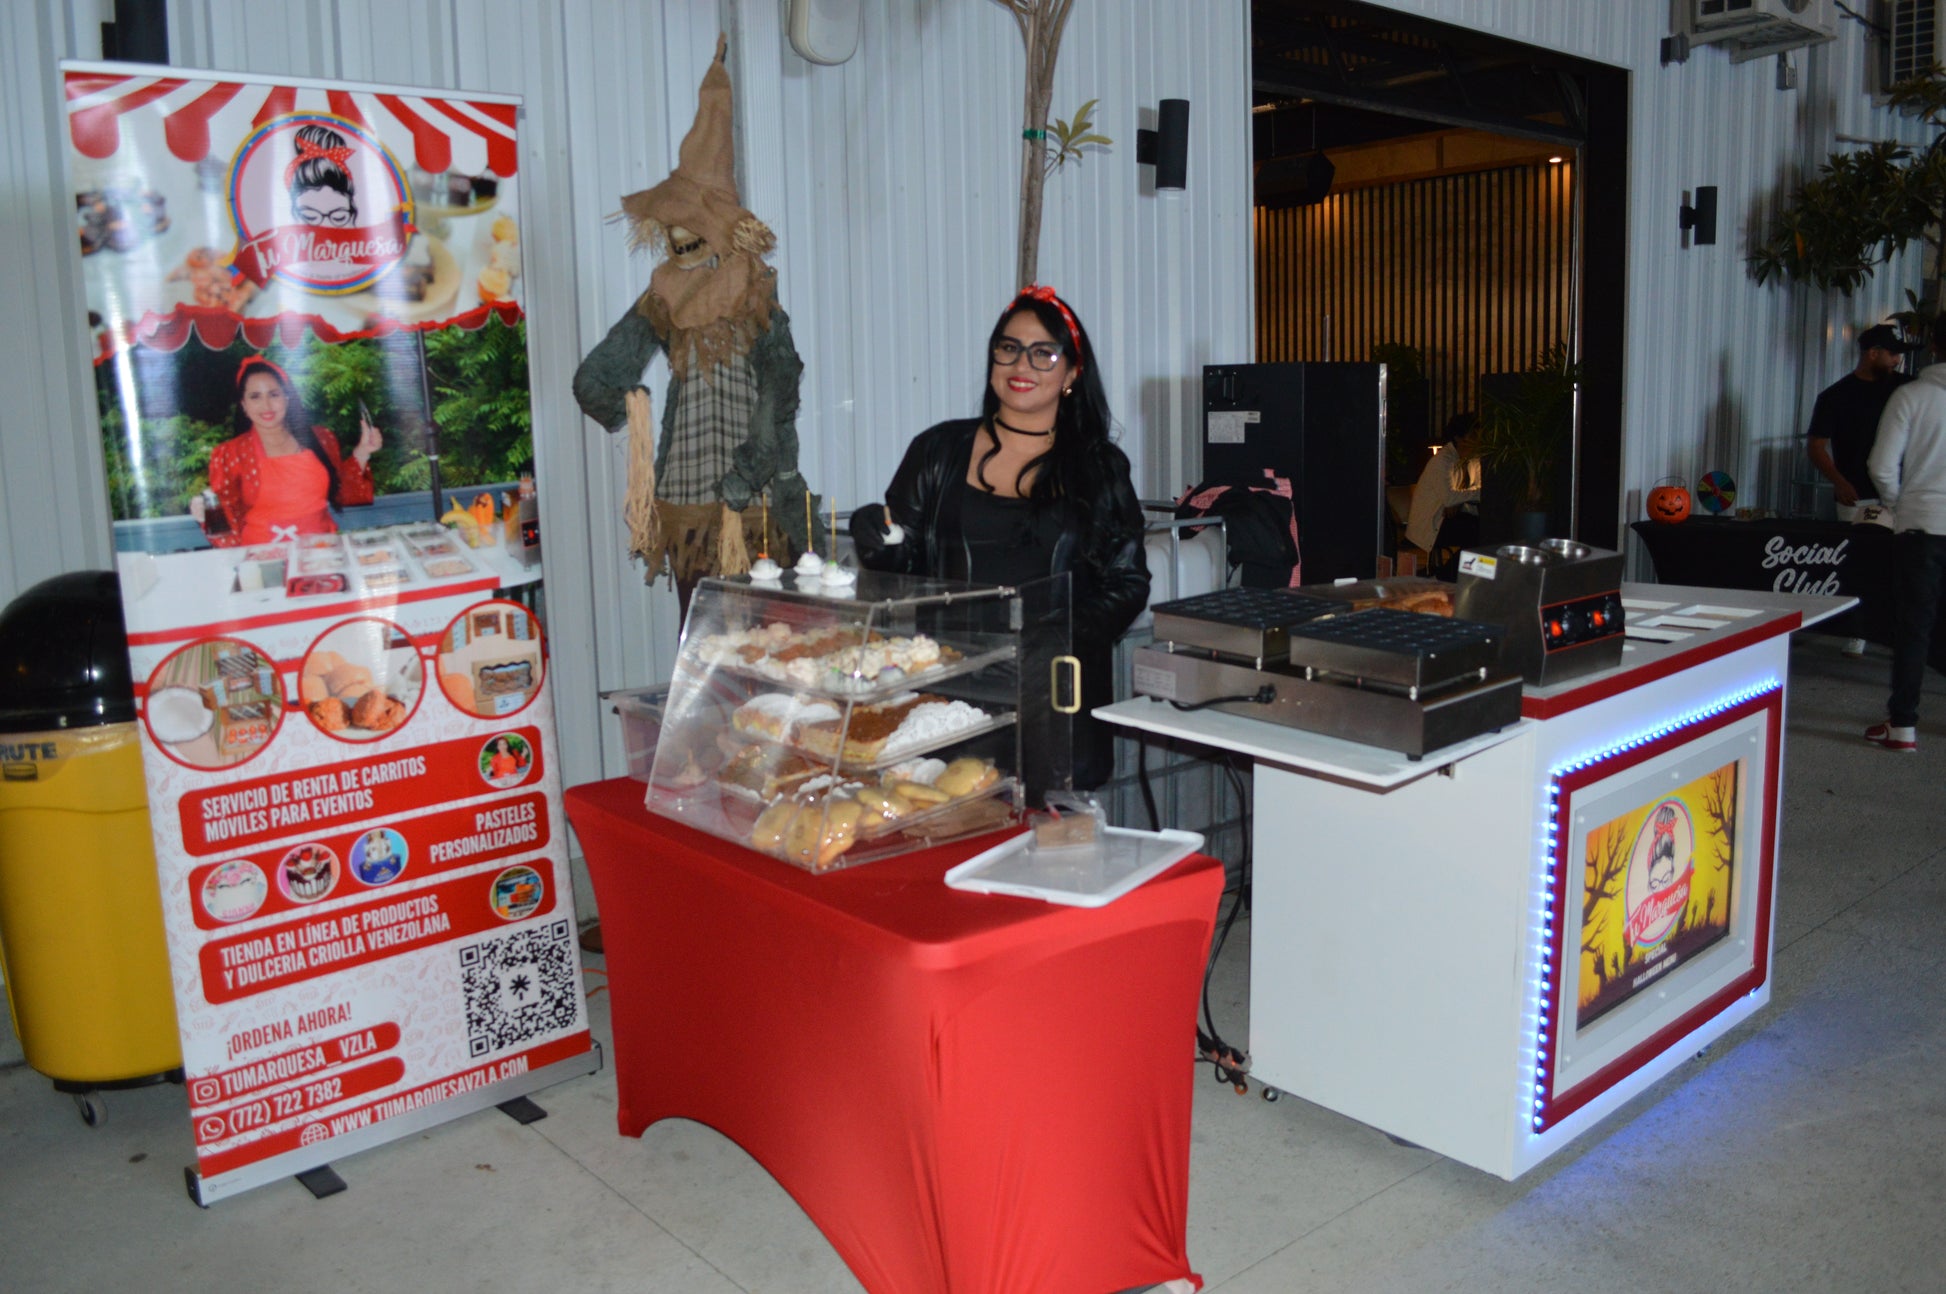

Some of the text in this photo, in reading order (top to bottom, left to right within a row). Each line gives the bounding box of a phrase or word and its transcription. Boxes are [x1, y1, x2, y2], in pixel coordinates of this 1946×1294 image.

[241, 228, 403, 279] Tu Marquesa
[1761, 535, 1850, 569] Social
[1773, 568, 1840, 596] Club
[202, 756, 427, 819] SERVICIO DE RENTA DE CARRITOS
[205, 789, 374, 842] MÓVILES PARA EVENTOS
[475, 801, 536, 832] PASTELES
[429, 822, 538, 864] PERSONALIZADOS
[220, 894, 439, 968] TIENDA EN LÍNEA DE PRODUCTOS
[223, 912, 451, 990] Y DULCERIA CRIOLLA VENEZOLANA
[226, 1001, 352, 1061] ¡ORDENA AHORA!
[229, 1077, 343, 1133] (772) 722 7382
[330, 1055, 529, 1137] WWWTUMARQUESAVZLA.COM
